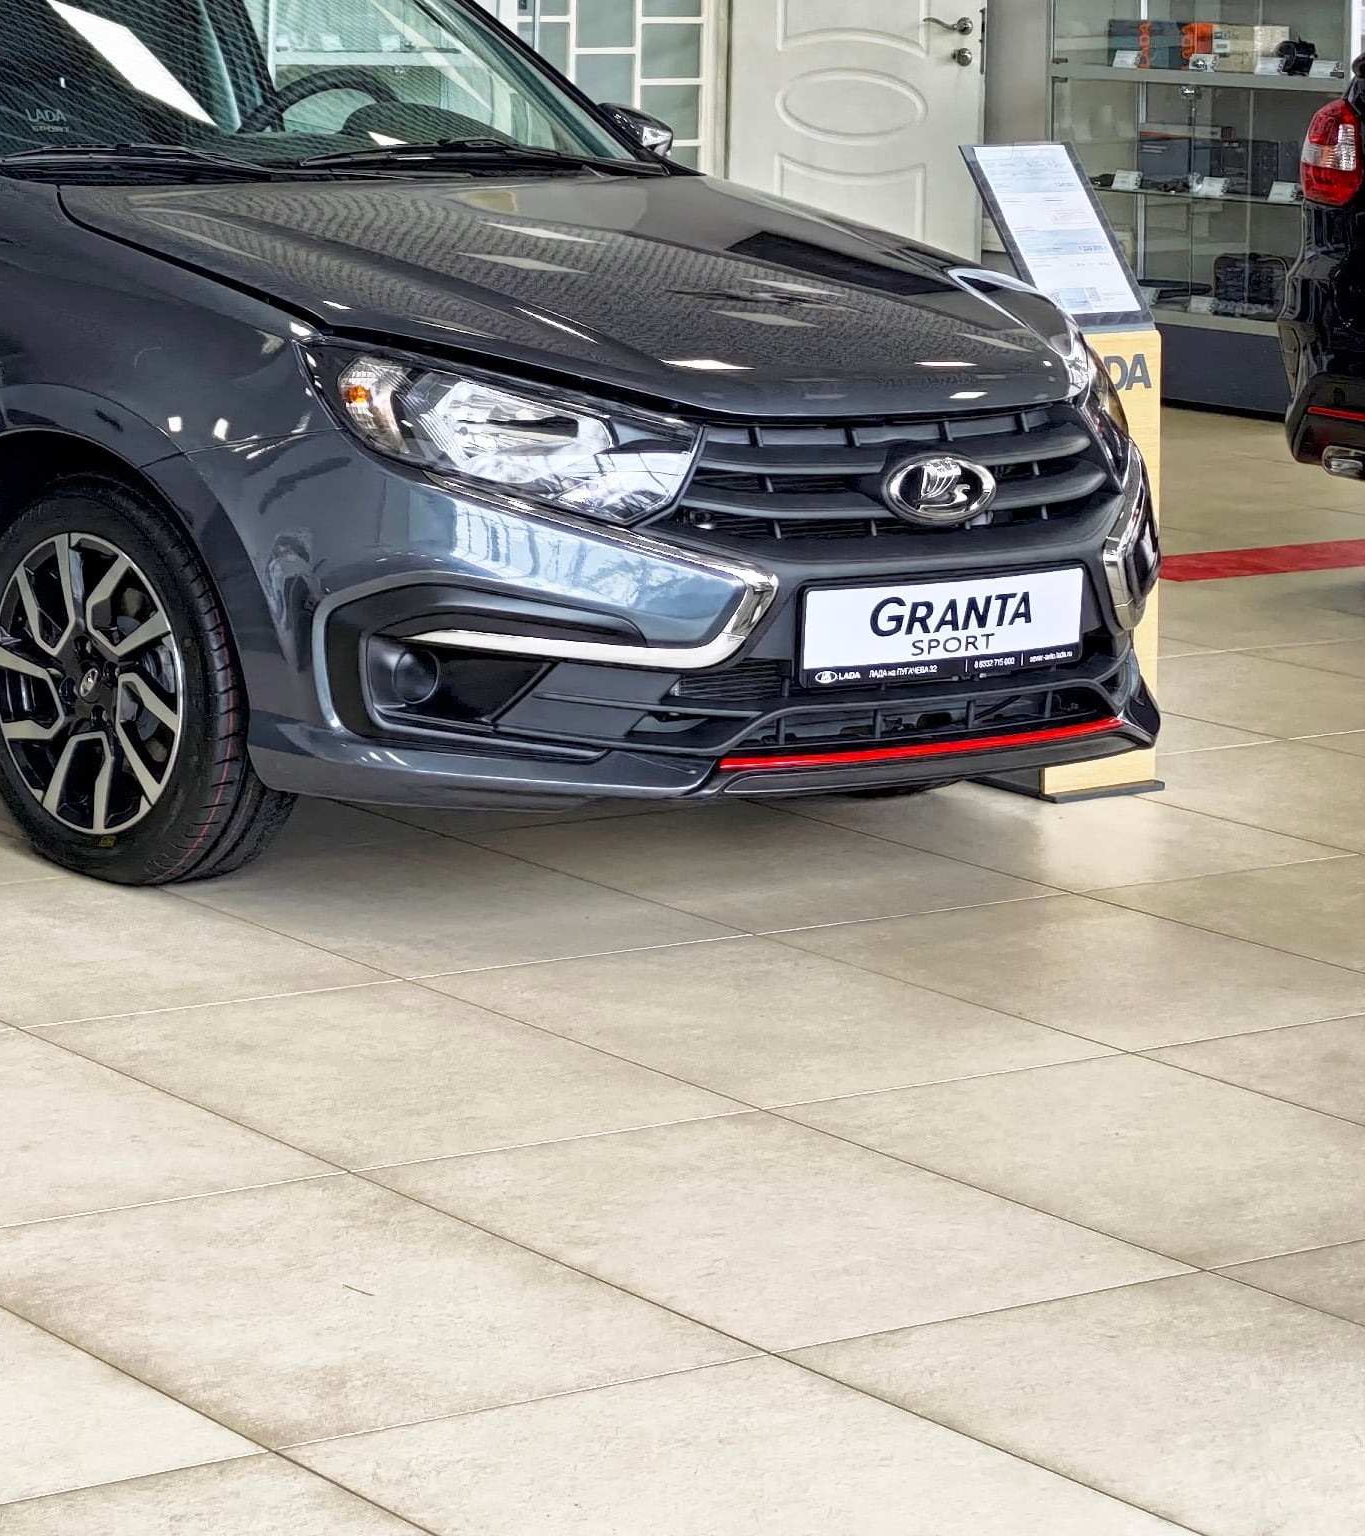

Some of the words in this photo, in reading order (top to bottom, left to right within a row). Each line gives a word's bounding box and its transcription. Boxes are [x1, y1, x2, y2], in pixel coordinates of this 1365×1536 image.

[25, 108, 67, 122] LADA
[1105, 353, 1152, 391] DA
[870, 591, 1032, 637] GRANTA
[911, 633, 995, 656] SPORT
[838, 671, 861, 681] LADA
[896, 665, 929, 676] ПУГАЧЕВА
